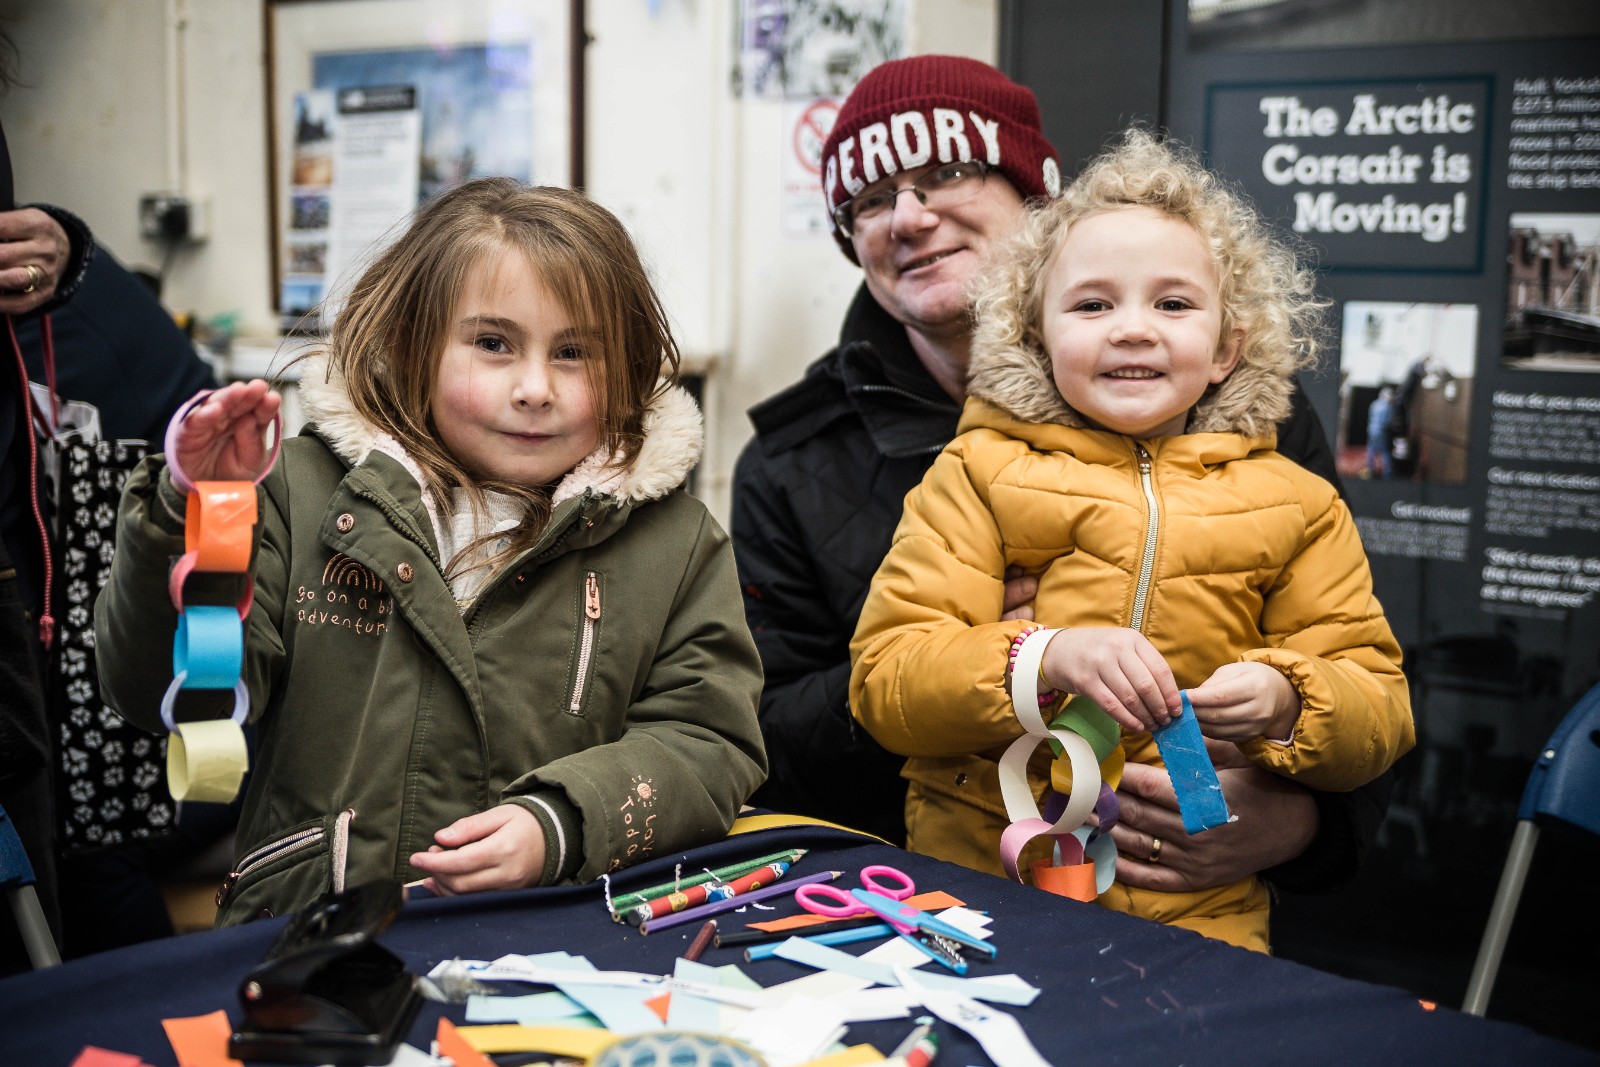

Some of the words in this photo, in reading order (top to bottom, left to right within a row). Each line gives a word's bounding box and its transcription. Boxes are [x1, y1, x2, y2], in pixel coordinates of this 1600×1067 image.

[1260, 97, 1338, 137] The
[1344, 94, 1475, 136] Arctic
[1262, 143, 1423, 186] Corsair
[1430, 144, 1472, 183] is
[1292, 191, 1467, 242] Moving!
[296, 586, 315, 603] go
[327, 590, 347, 604] on
[358, 598, 368, 610] a
